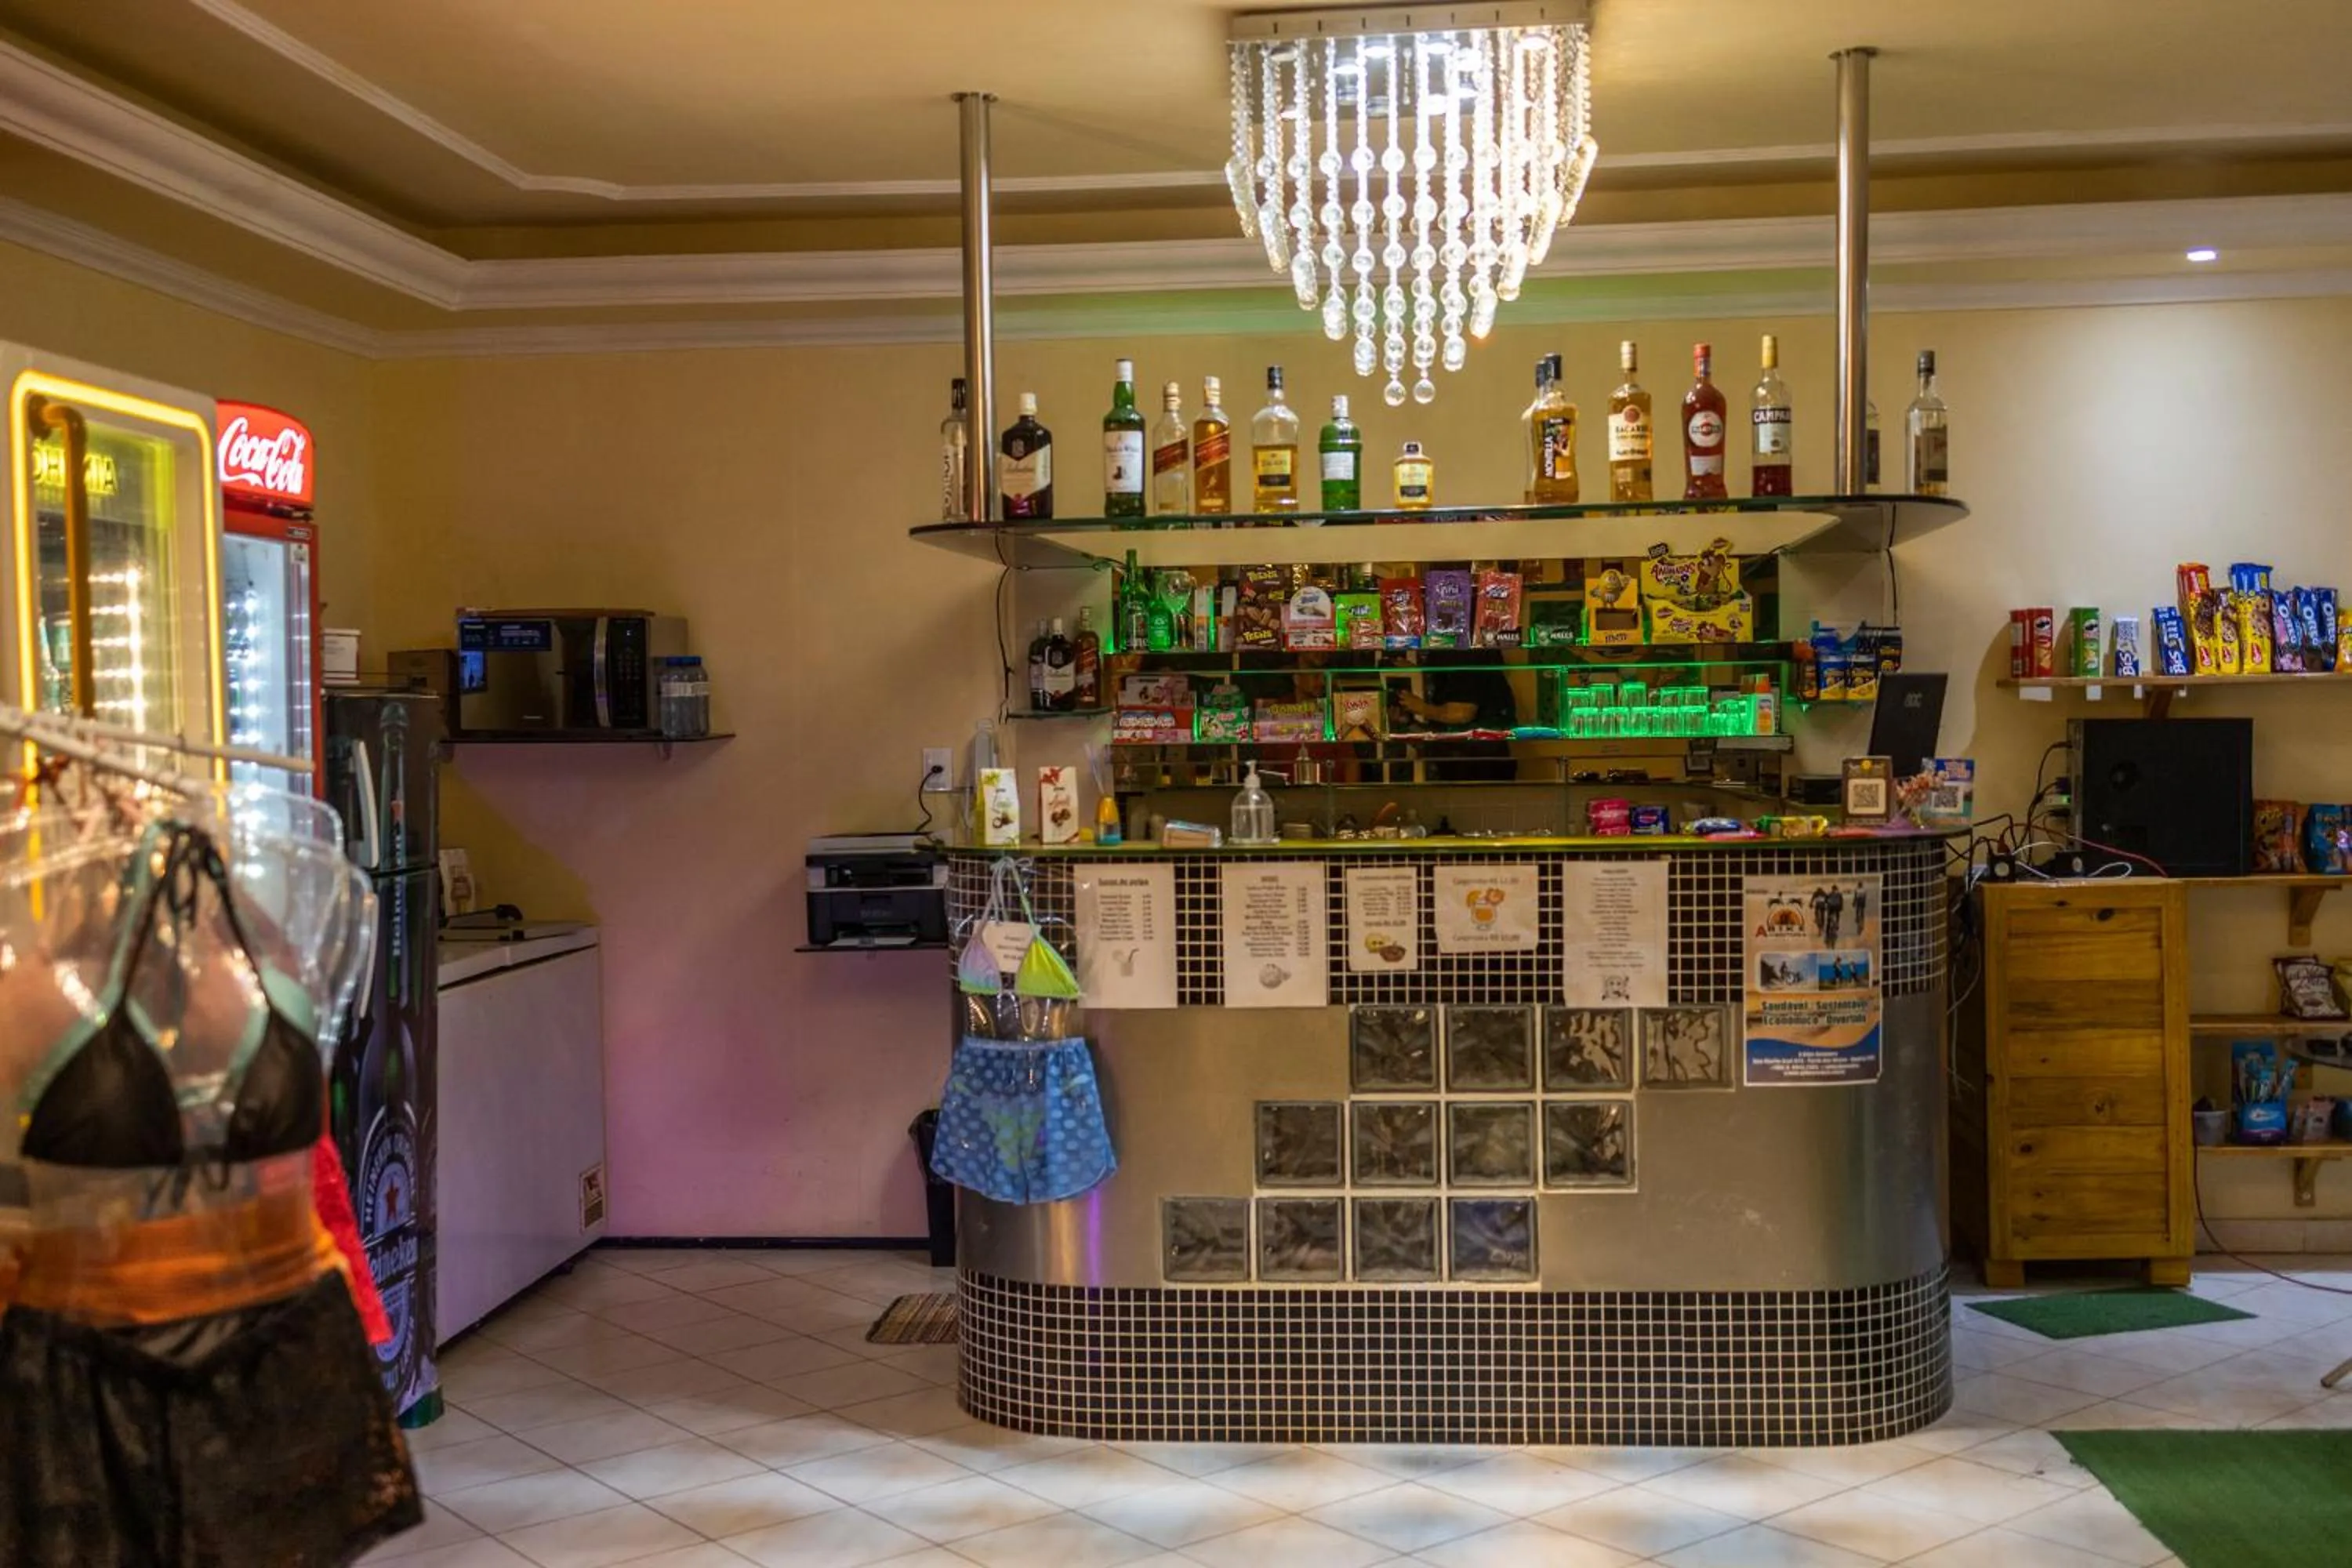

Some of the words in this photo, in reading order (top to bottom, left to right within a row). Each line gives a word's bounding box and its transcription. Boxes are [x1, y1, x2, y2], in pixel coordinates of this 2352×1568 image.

[218, 416, 306, 495] Coca-Cola
[2278, 604, 2297, 644] OREO
[2303, 606, 2319, 645] OREO
[2323, 602, 2335, 643] OREO
[371, 1235, 418, 1276] eineken
